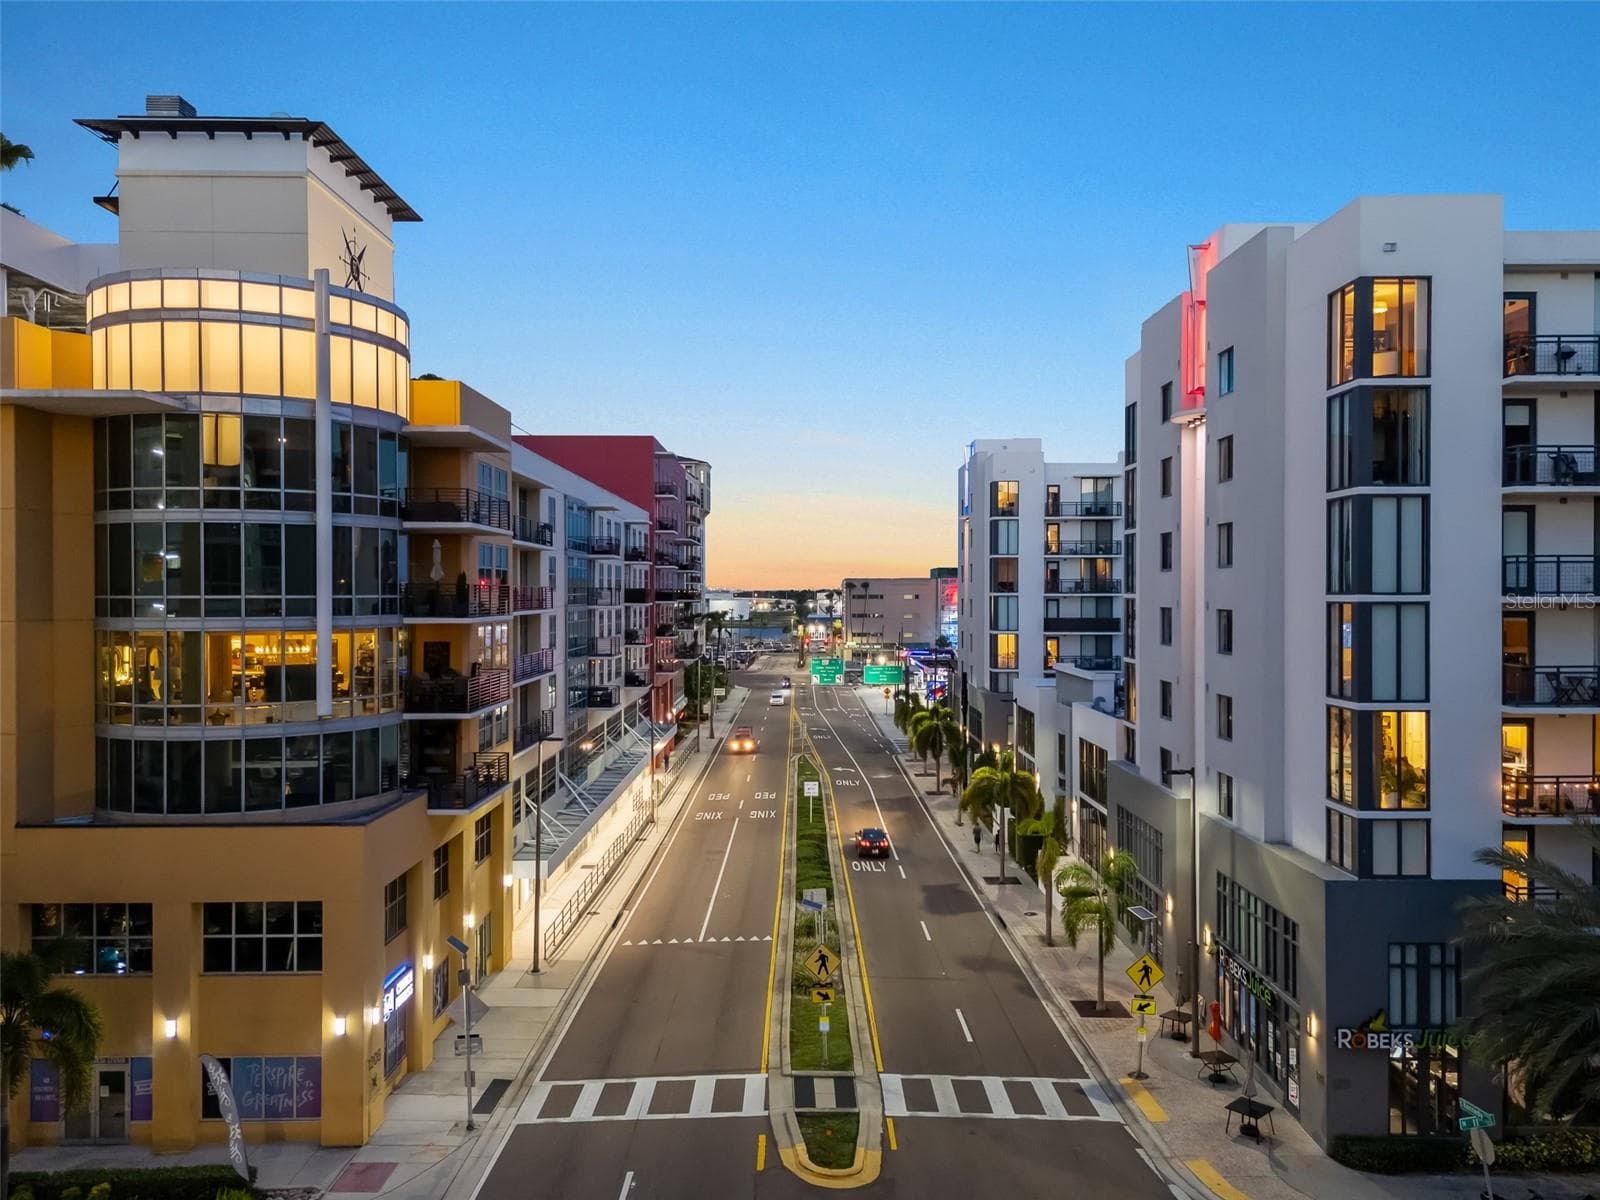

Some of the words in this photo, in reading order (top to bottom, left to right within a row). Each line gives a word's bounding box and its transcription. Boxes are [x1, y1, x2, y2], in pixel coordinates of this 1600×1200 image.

[708, 793, 730, 801] PED
[754, 791, 777, 799] PED
[695, 811, 723, 821] XING
[750, 810, 777, 819] XING
[851, 860, 887, 872] ONLY
[1219, 945, 1247, 985] ROBEKS
[1337, 1028, 1414, 1050] ROBEKS
